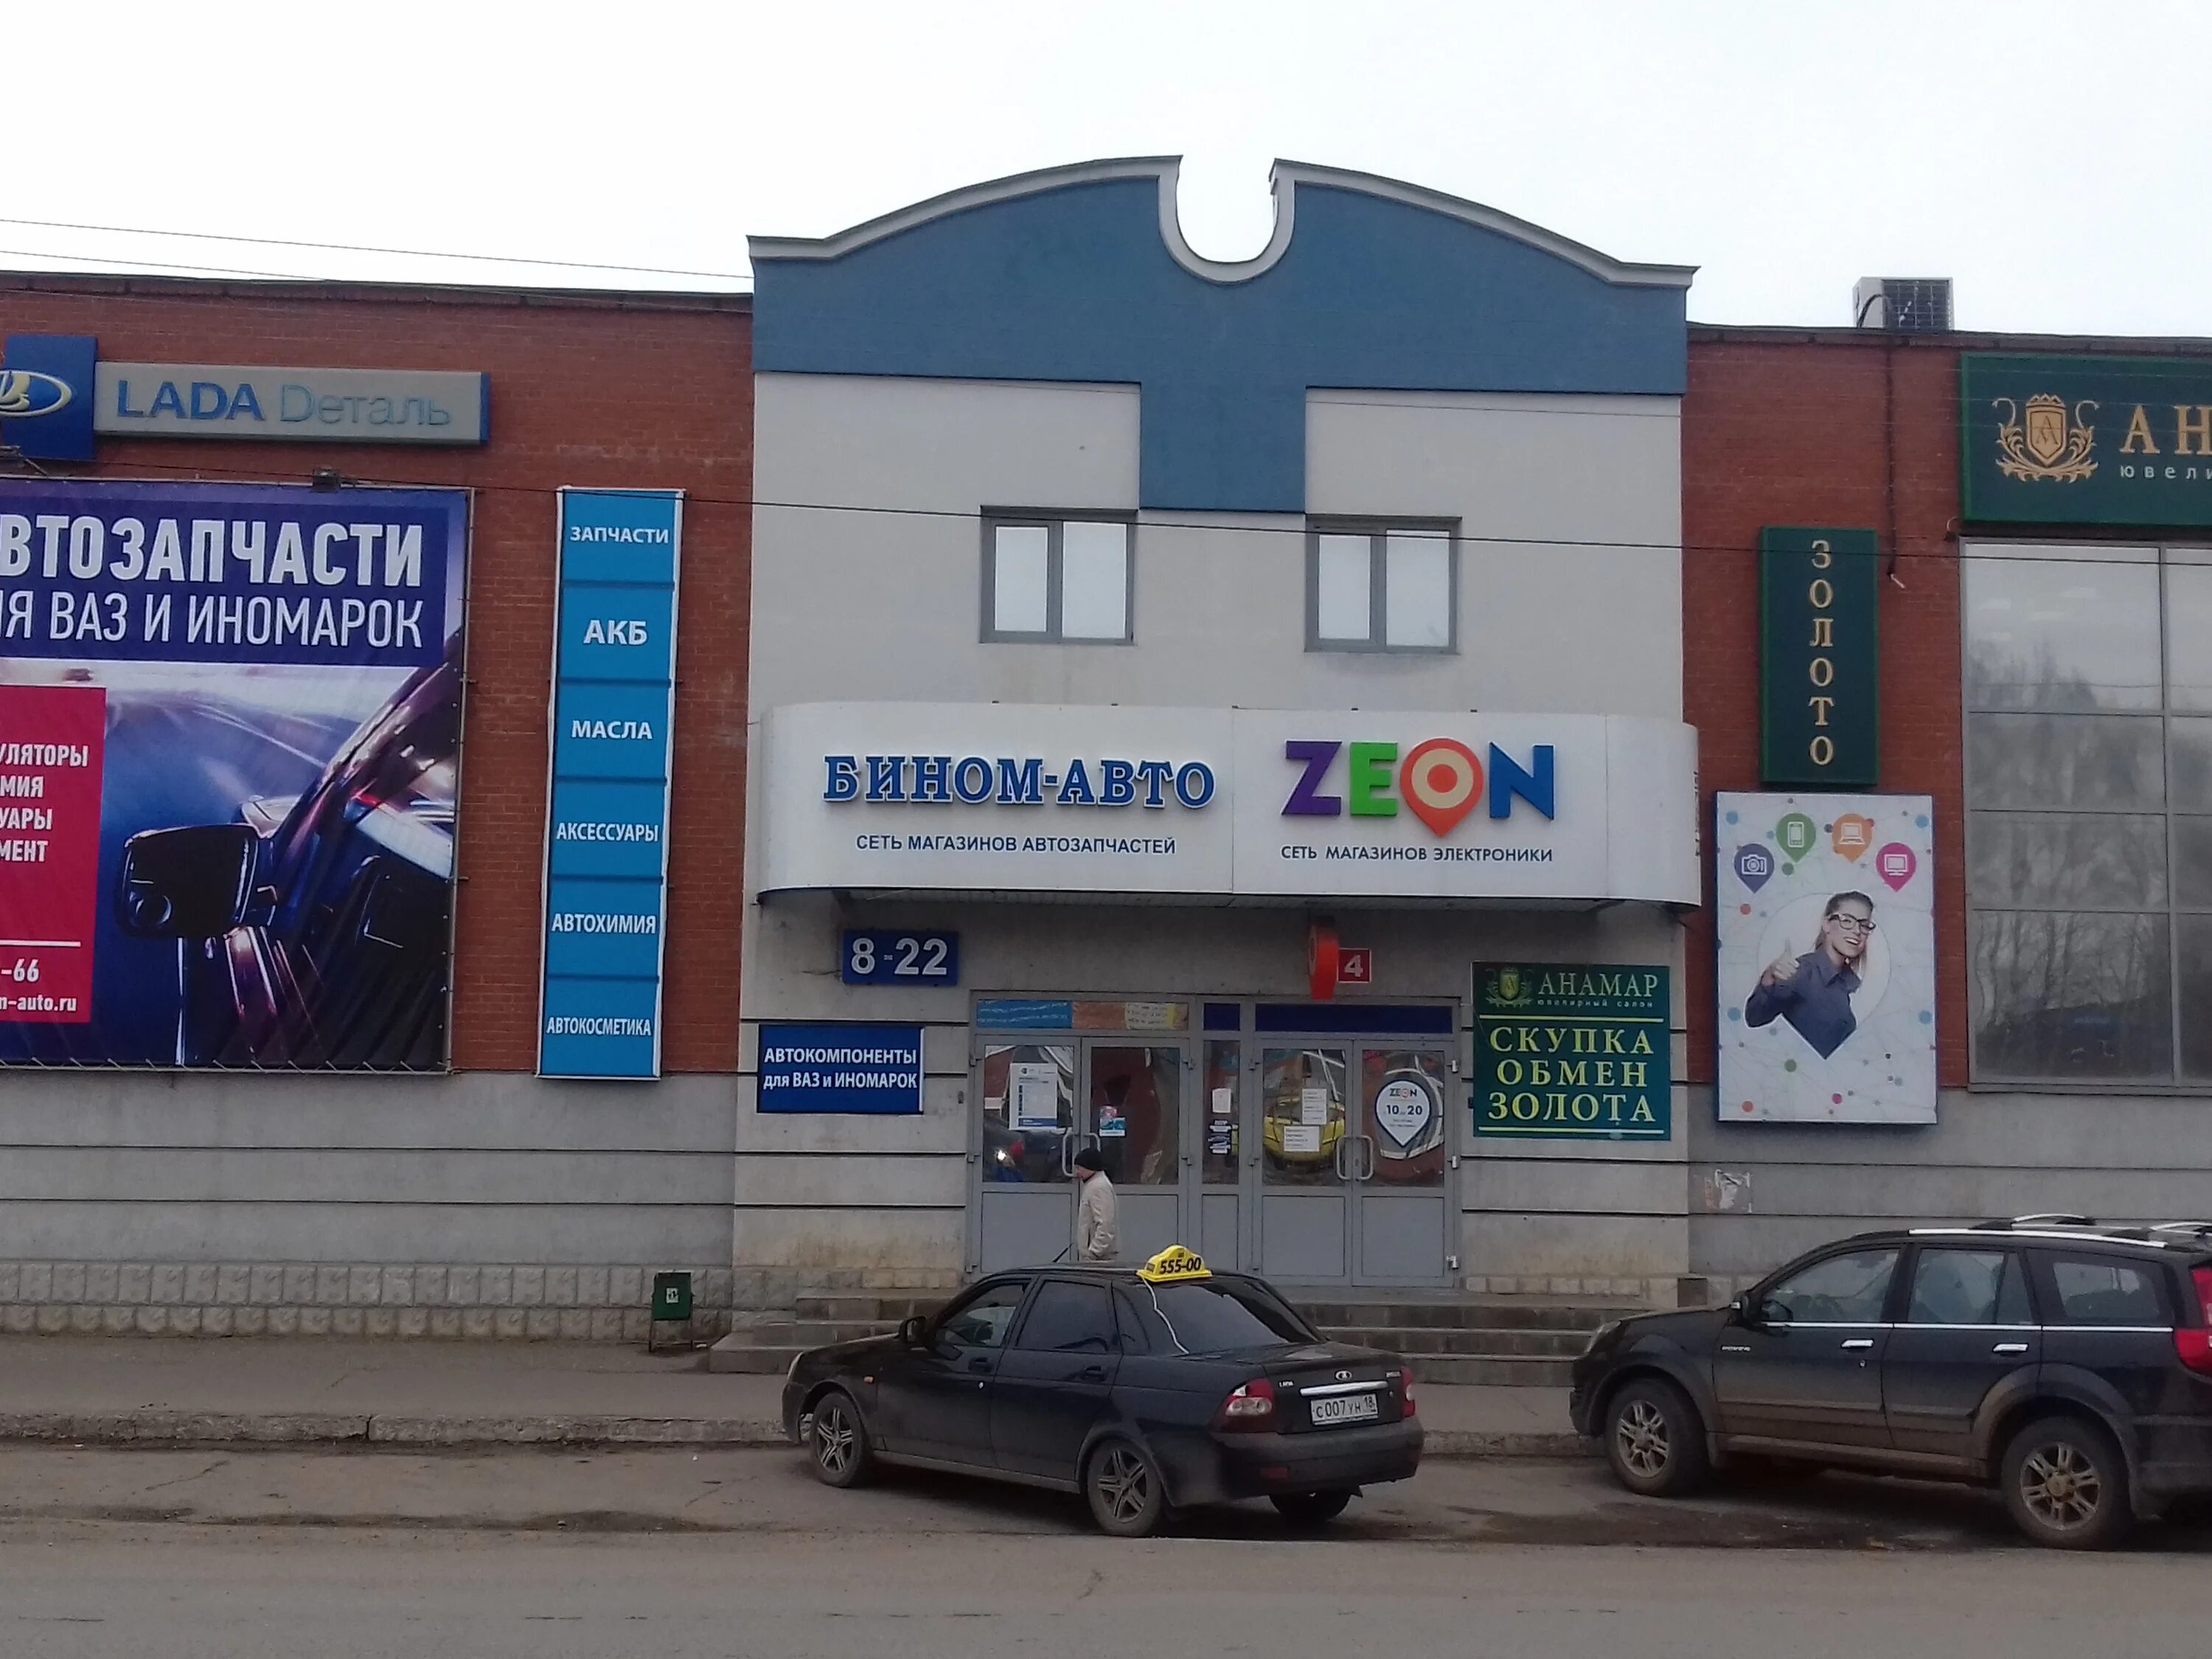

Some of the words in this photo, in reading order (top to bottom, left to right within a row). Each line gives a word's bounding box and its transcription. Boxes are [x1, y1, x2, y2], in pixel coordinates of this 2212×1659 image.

[116, 380, 265, 421] LADA
[570, 525, 669, 545] ЗАПЧАСТИ
[0, 514, 422, 587] ВТОЗАПЧАСТИ
[49, 591, 127, 641] ВАЗ
[145, 594, 172, 643] И
[188, 595, 423, 648] ИНОМАРОК
[583, 619, 648, 646] АКБ
[1809, 539, 1834, 766] ЗОЛОТО
[571, 720, 653, 740] МАСЛА
[0, 775, 44, 797] МИЯ
[822, 754, 1217, 810] БИНОМ-АВТО
[1281, 738, 1554, 837] ZEON
[555, 822, 658, 843] АКСЕССУАРЫ
[856, 834, 902, 851] СЕТЬ
[908, 835, 1017, 852] МАГАЗИНОВ
[1023, 835, 1176, 855] АВТОЗАПЧАСТЕЙ
[1281, 846, 1318, 860] СЕТЬ
[1325, 846, 1427, 861] МАГАЗИНОВ
[1433, 848, 1553, 862] ЭЛЕКТРОНИКИ
[552, 914, 656, 935] АВТОХИМИЯ
[1344, 954, 1363, 977] 4
[1538, 973, 1658, 998] АНАМАР
[1537, 999, 1608, 1007] ювелирный
[546, 1018, 652, 1037] АВТОКОСМЕТИКА
[1489, 1026, 1654, 1054] СКУПКА
[764, 1048, 917, 1065] АВТОКОМПОНЕНТЫ
[763, 1074, 790, 1091] для
[793, 1072, 820, 1088] ВАЗ
[835, 1073, 917, 1089] ИНОМАРОК
[1497, 1059, 1647, 1087] ОБМЕН
[1488, 1092, 1656, 1122] ЗОЛОТА
[1160, 1257, 1202, 1275] 555-00
